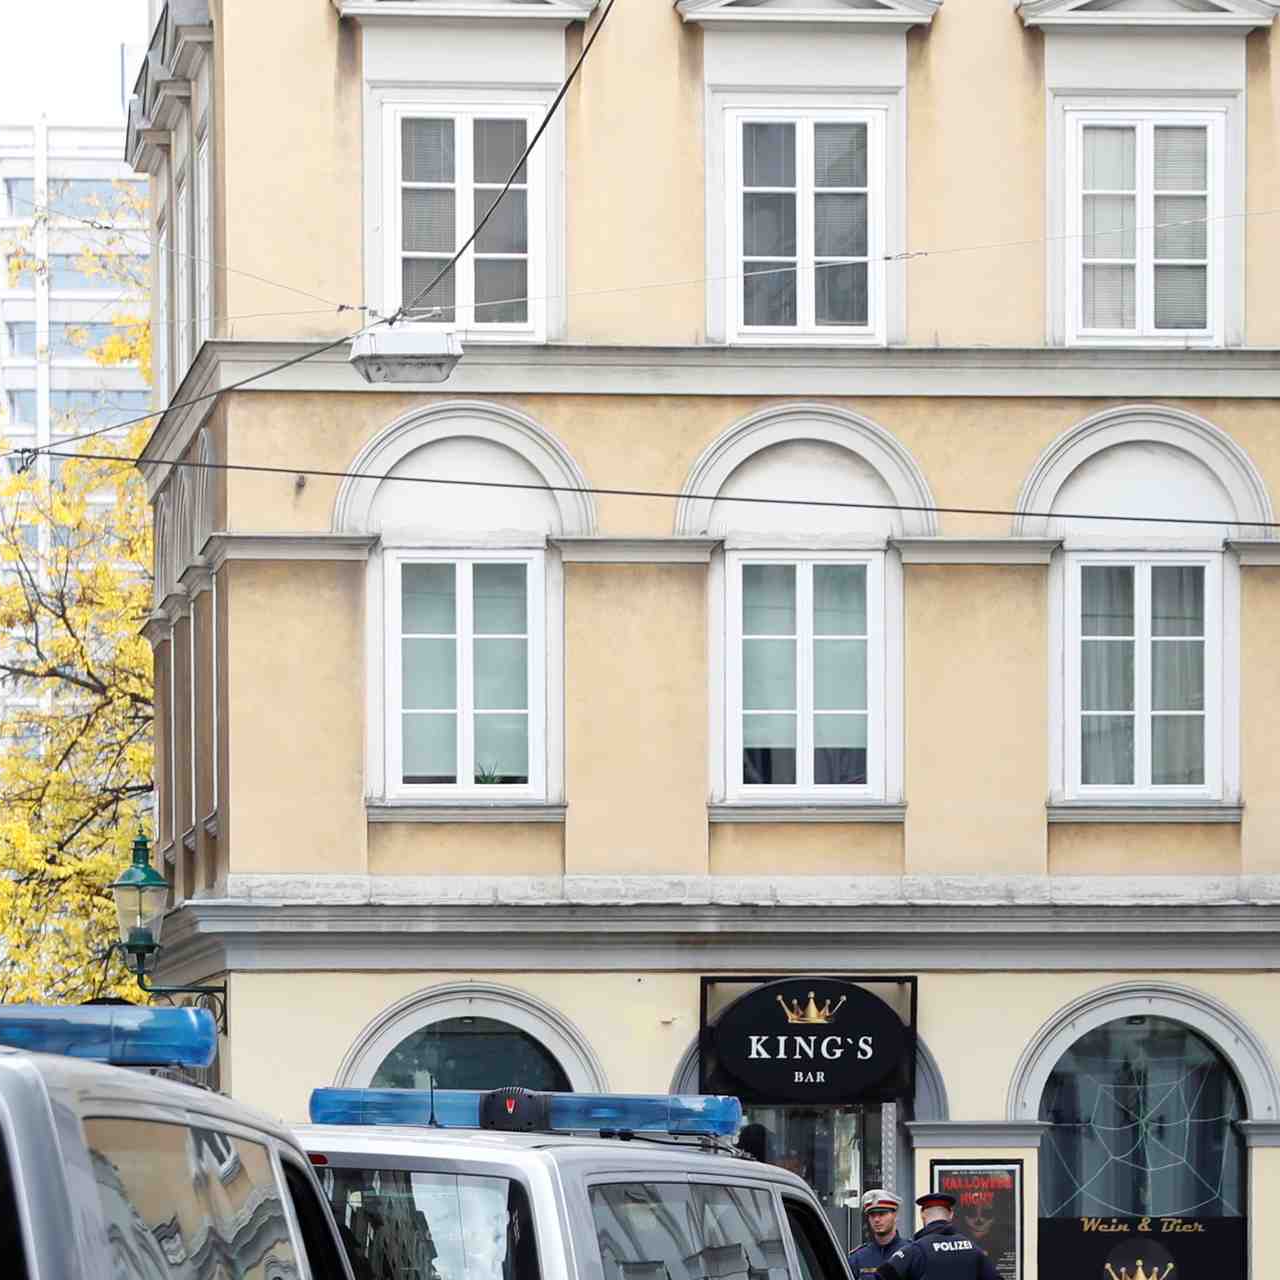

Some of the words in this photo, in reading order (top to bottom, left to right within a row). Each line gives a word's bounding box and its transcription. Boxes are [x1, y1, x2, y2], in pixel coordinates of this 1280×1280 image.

[794, 1071, 825, 1082] BAR
[1080, 1216, 1131, 1232] Wein
[1137, 1216, 1153, 1232] &
[1160, 1217, 1206, 1232] Bier
[932, 1240, 973, 1252] POLIZEI
